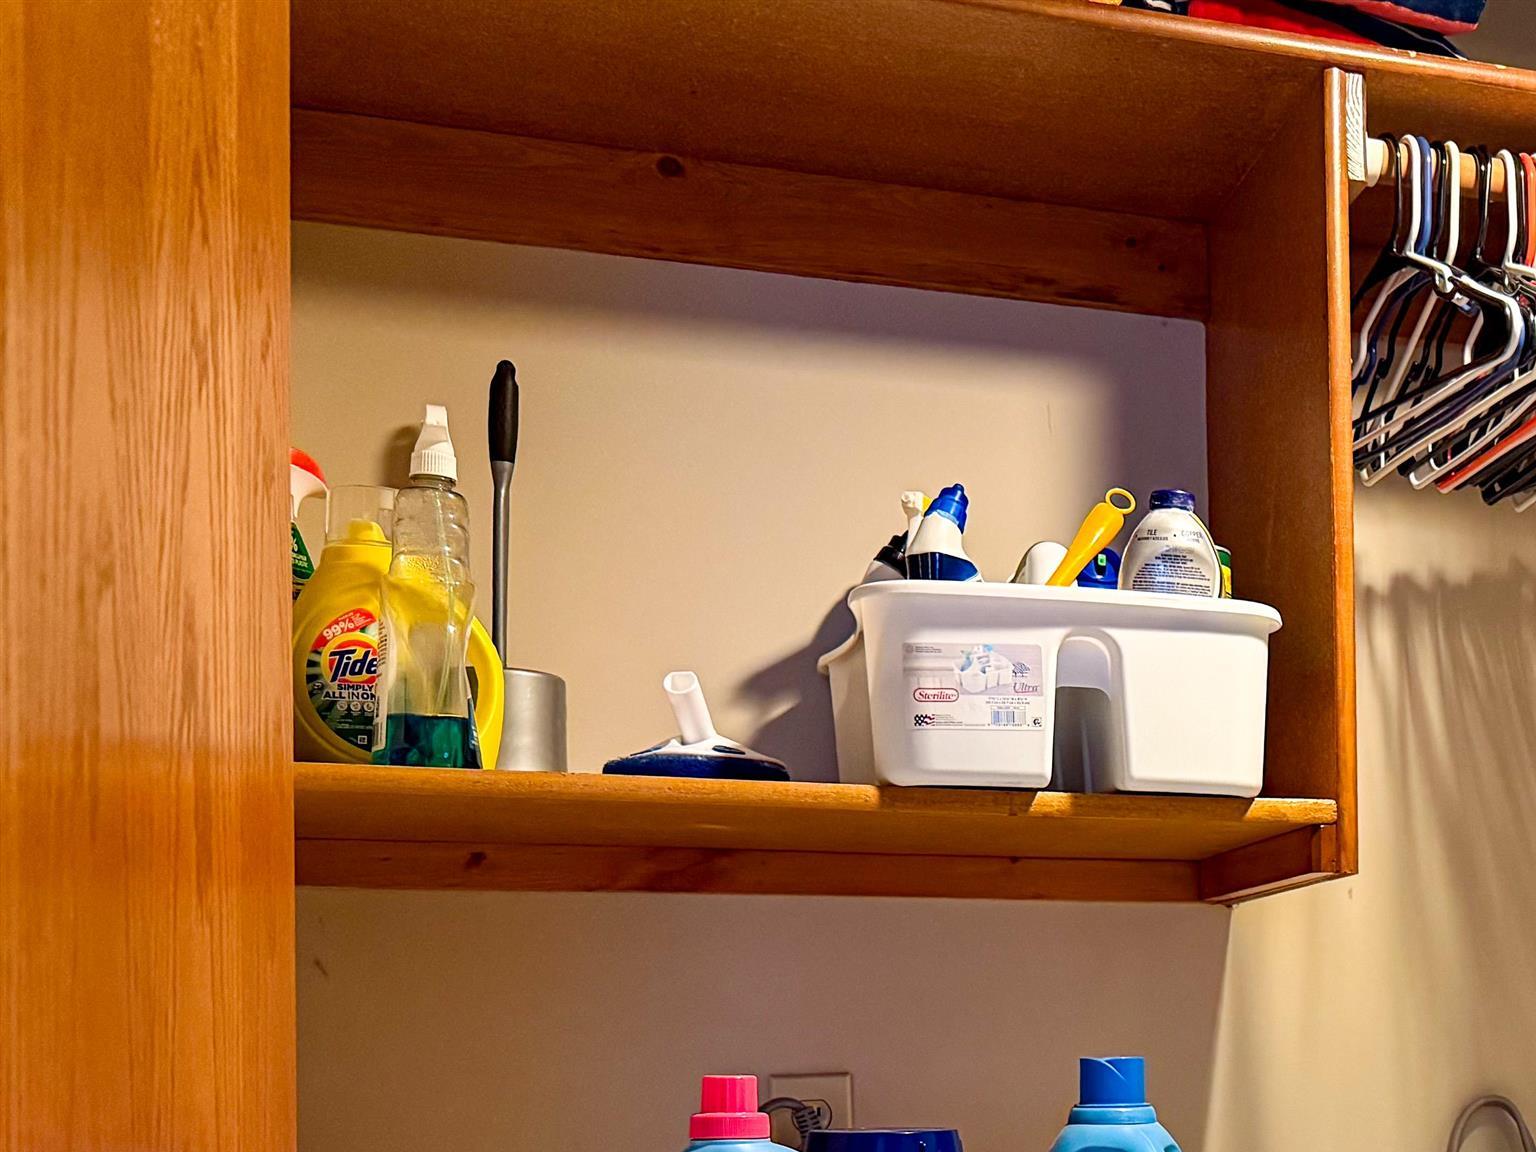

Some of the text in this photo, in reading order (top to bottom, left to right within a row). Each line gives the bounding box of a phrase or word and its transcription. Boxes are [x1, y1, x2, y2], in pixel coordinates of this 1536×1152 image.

[323, 619, 355, 640] 99%
[329, 648, 378, 683] Tide
[337, 684, 374, 692] SIMPLY
[1013, 682, 1040, 693] Ultra
[323, 691, 376, 701] ALL IN ON
[918, 691, 955, 700] Sterilite
